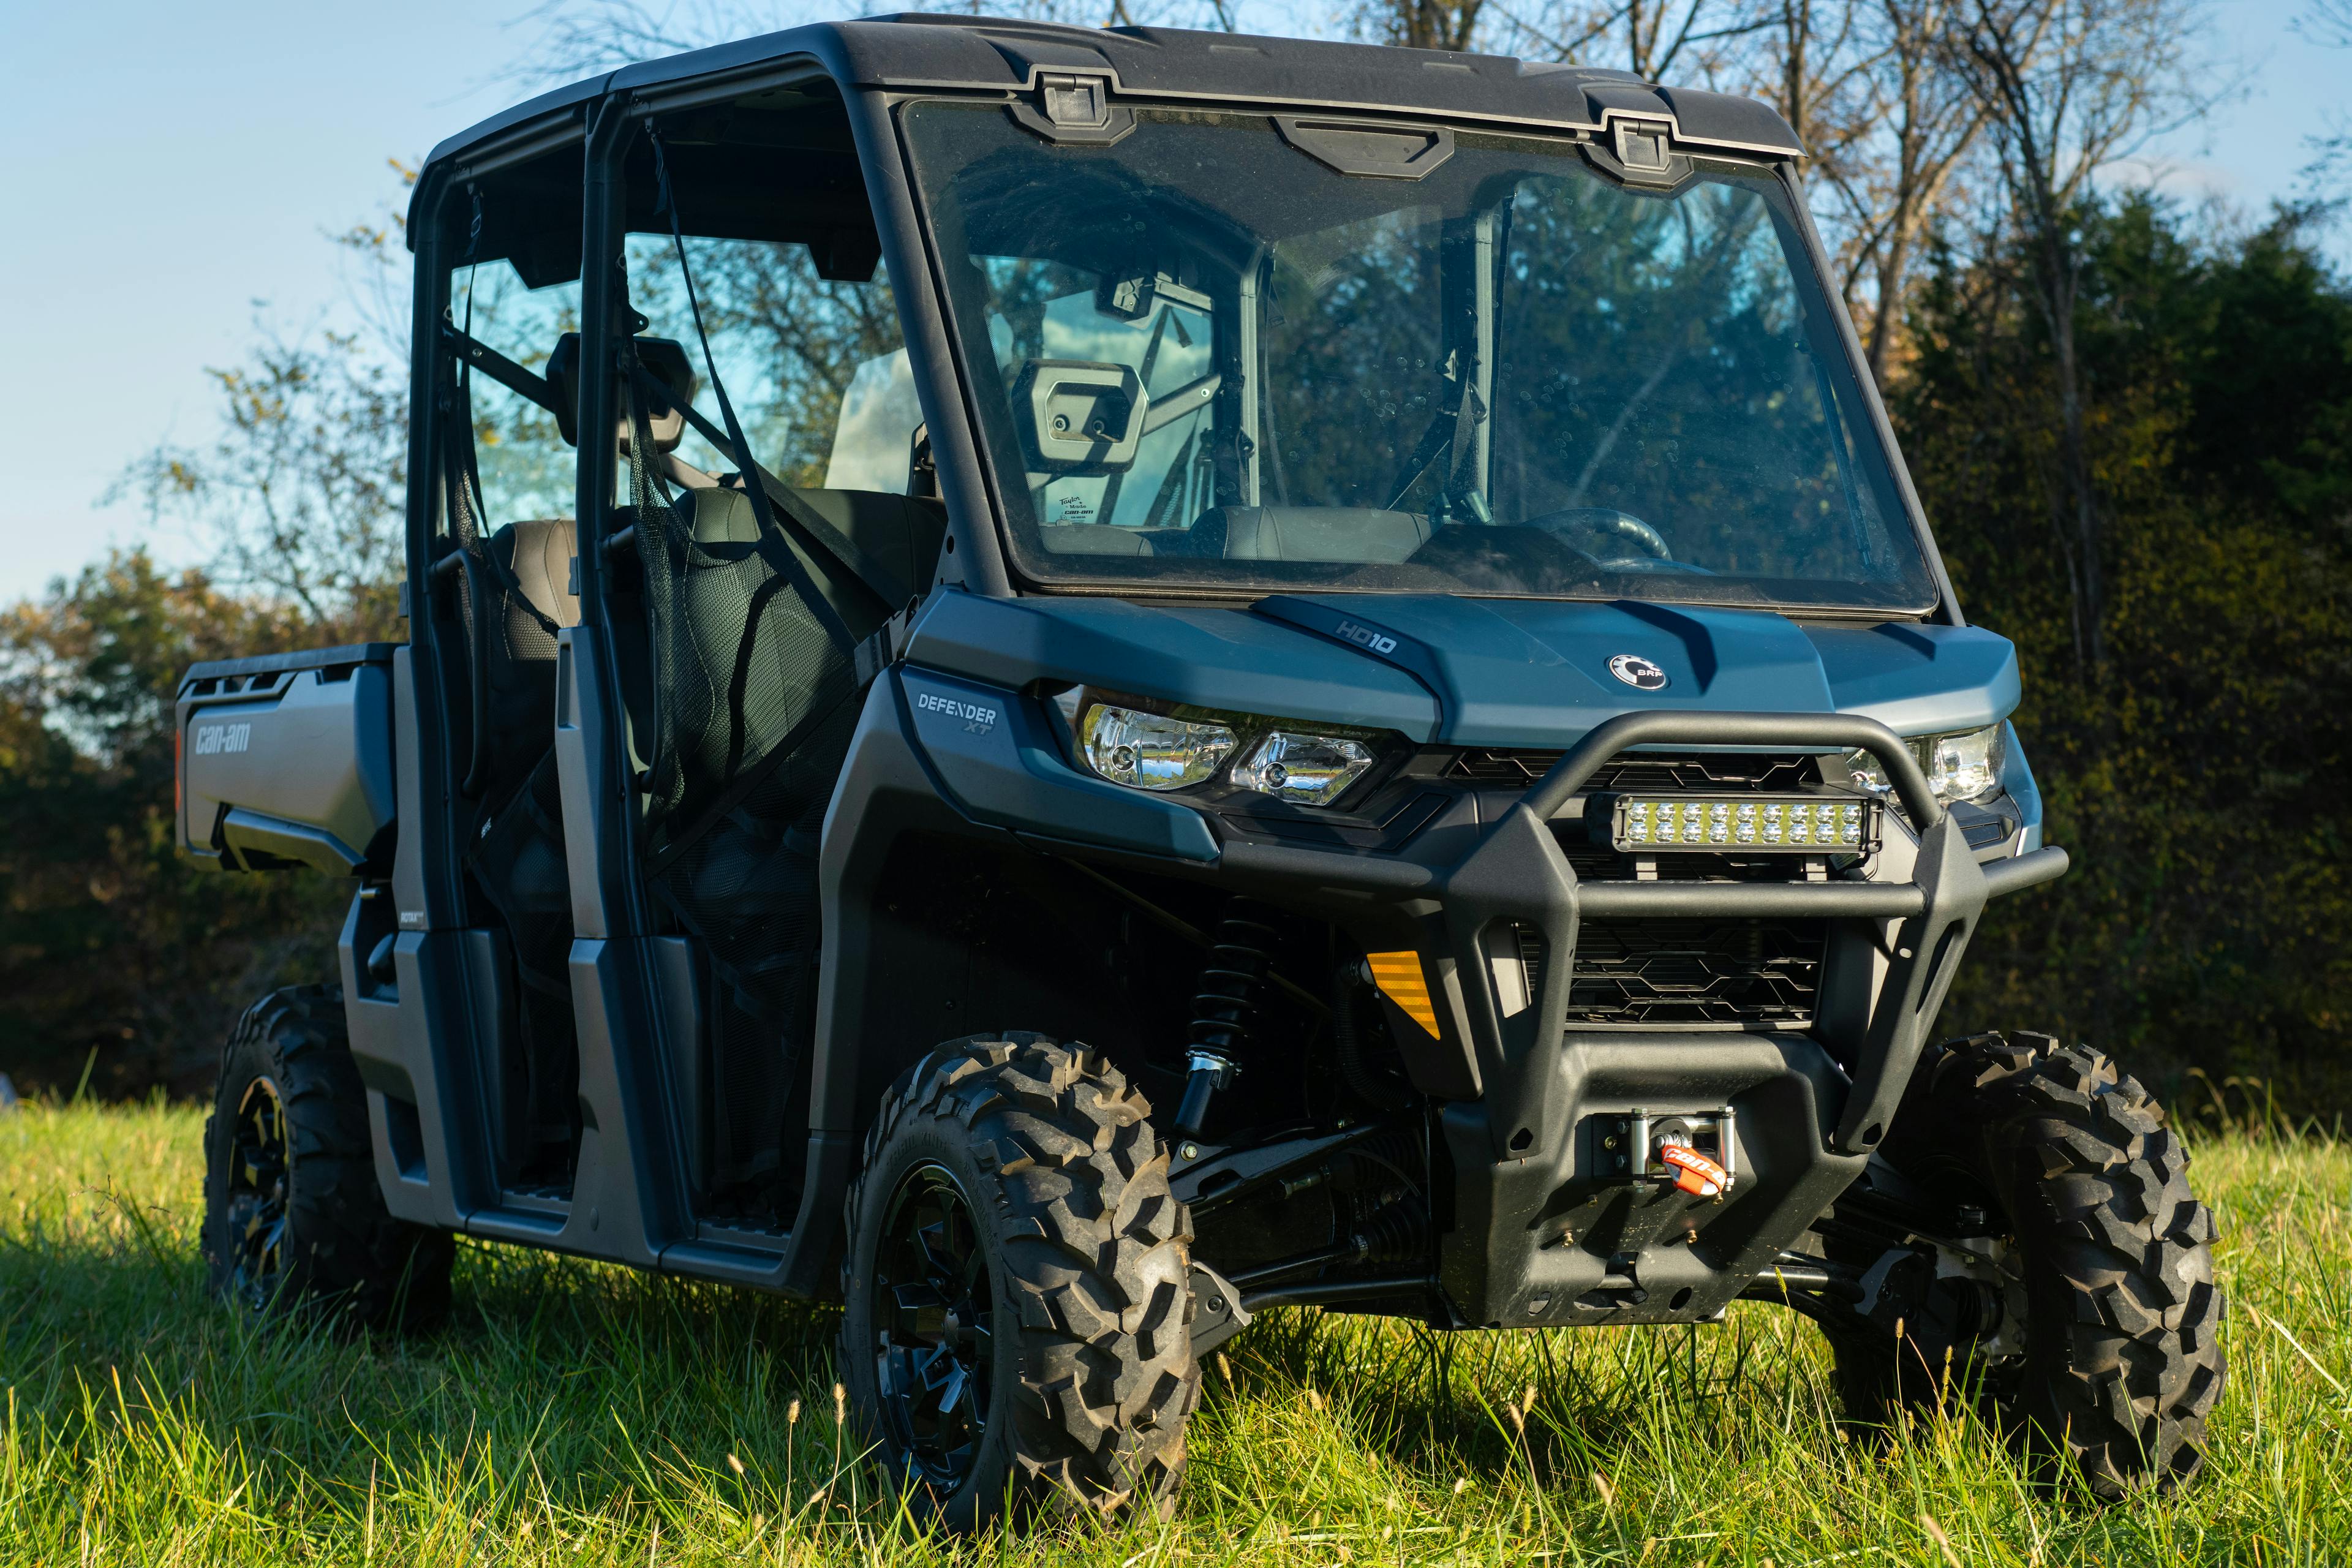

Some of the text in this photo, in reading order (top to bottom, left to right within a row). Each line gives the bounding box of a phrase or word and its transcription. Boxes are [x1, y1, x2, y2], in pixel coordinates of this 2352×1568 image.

[1059, 496, 1080, 505] Taylor
[1336, 620, 1397, 654] HD10
[918, 693, 996, 725] DEFENDER
[196, 723, 251, 755] can-am
[964, 721, 992, 735] XT
[1664, 1147, 1726, 1186] can-a
